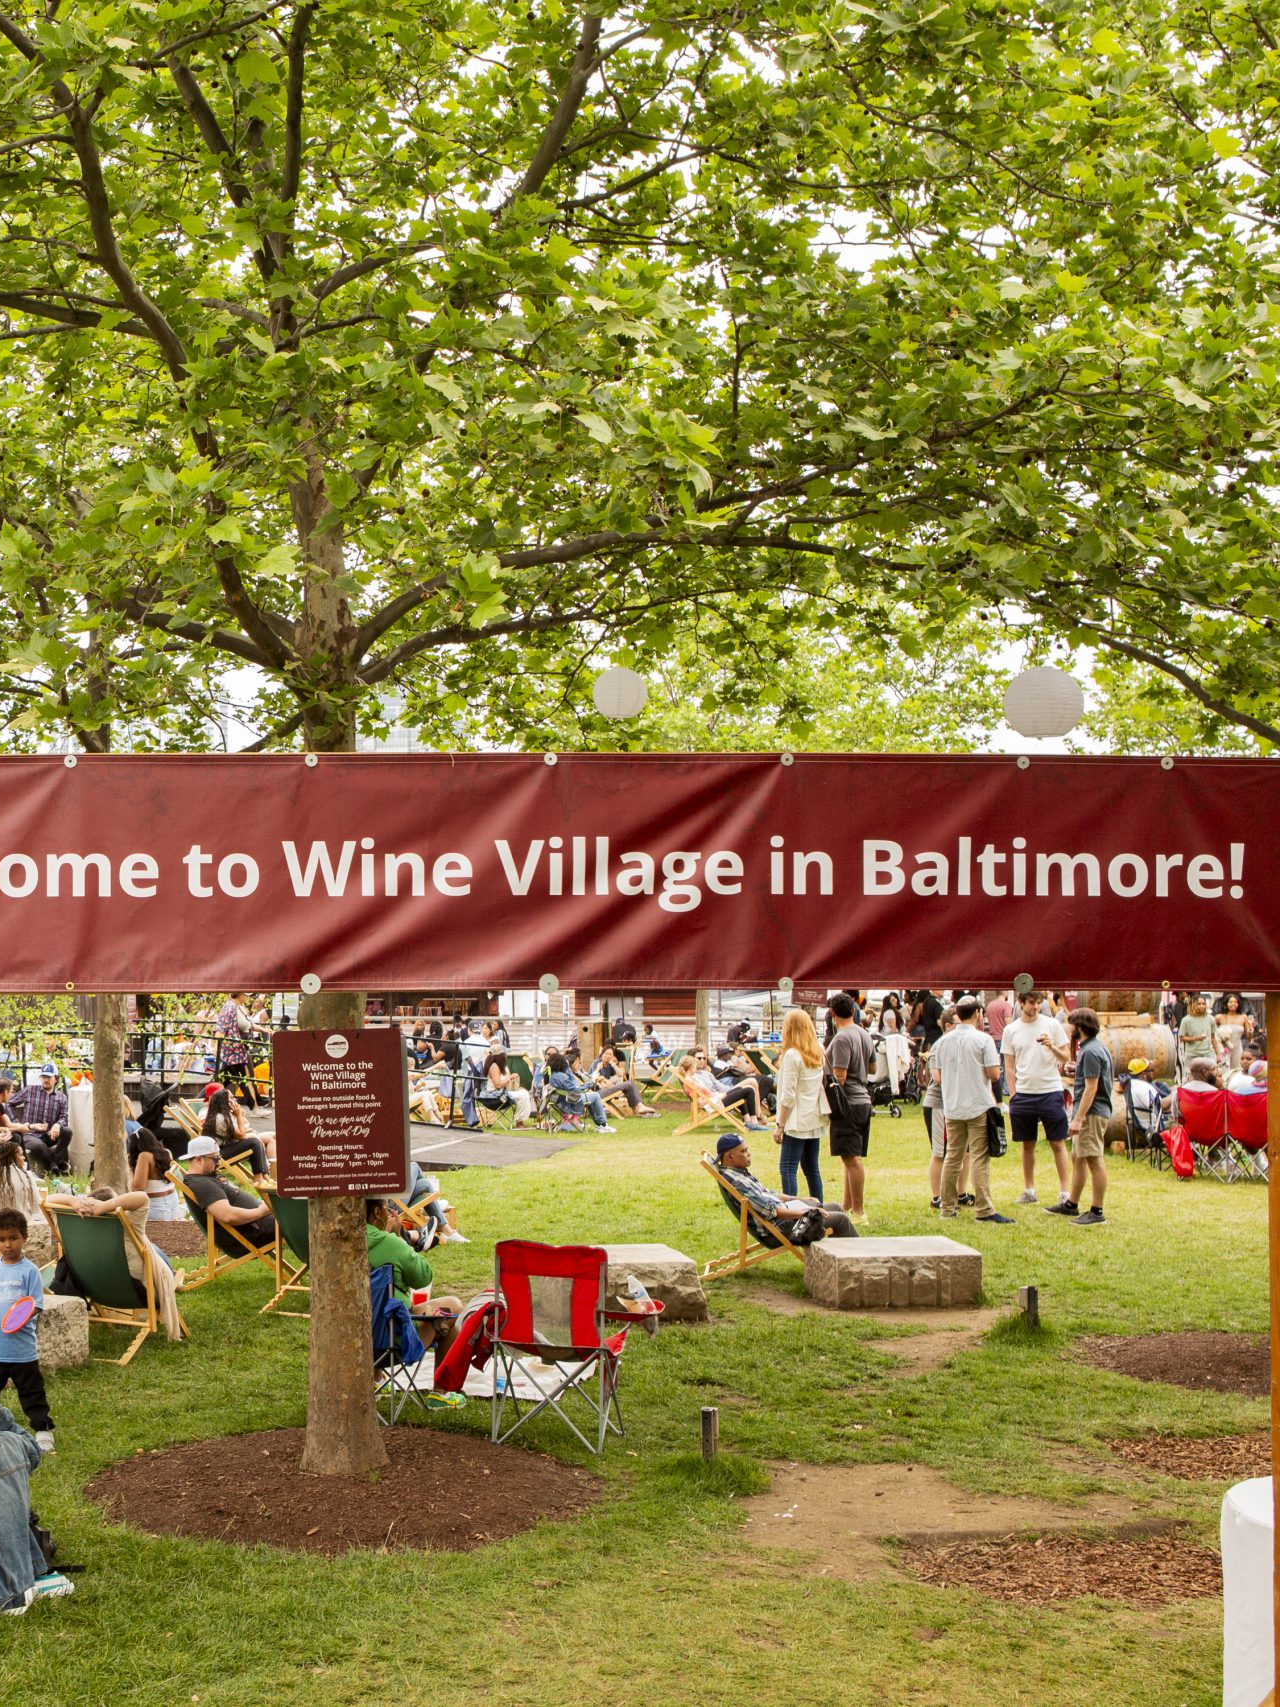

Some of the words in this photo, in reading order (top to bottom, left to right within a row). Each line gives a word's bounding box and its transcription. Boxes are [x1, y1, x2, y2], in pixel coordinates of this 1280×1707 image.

[182, 844, 260, 898] to
[281, 837, 473, 898] Wine
[494, 836, 744, 913] Village
[770, 835, 834, 896] in
[862, 836, 1245, 899] Baltimore!
[302, 1063, 344, 1071] Welcome
[346, 1062, 356, 1070] to
[358, 1061, 373, 1069] the
[310, 1072, 333, 1080] Wine
[335, 1071, 366, 1081] Village
[310, 1082, 319, 1090] in
[322, 1081, 367, 1089] Baltimore
[306, 1115, 324, 1125] We
[339, 1117, 355, 1126] open
[355, 1112, 375, 1123] until
[310, 1126, 352, 1138] Memorial
[351, 1126, 370, 1137] Day
